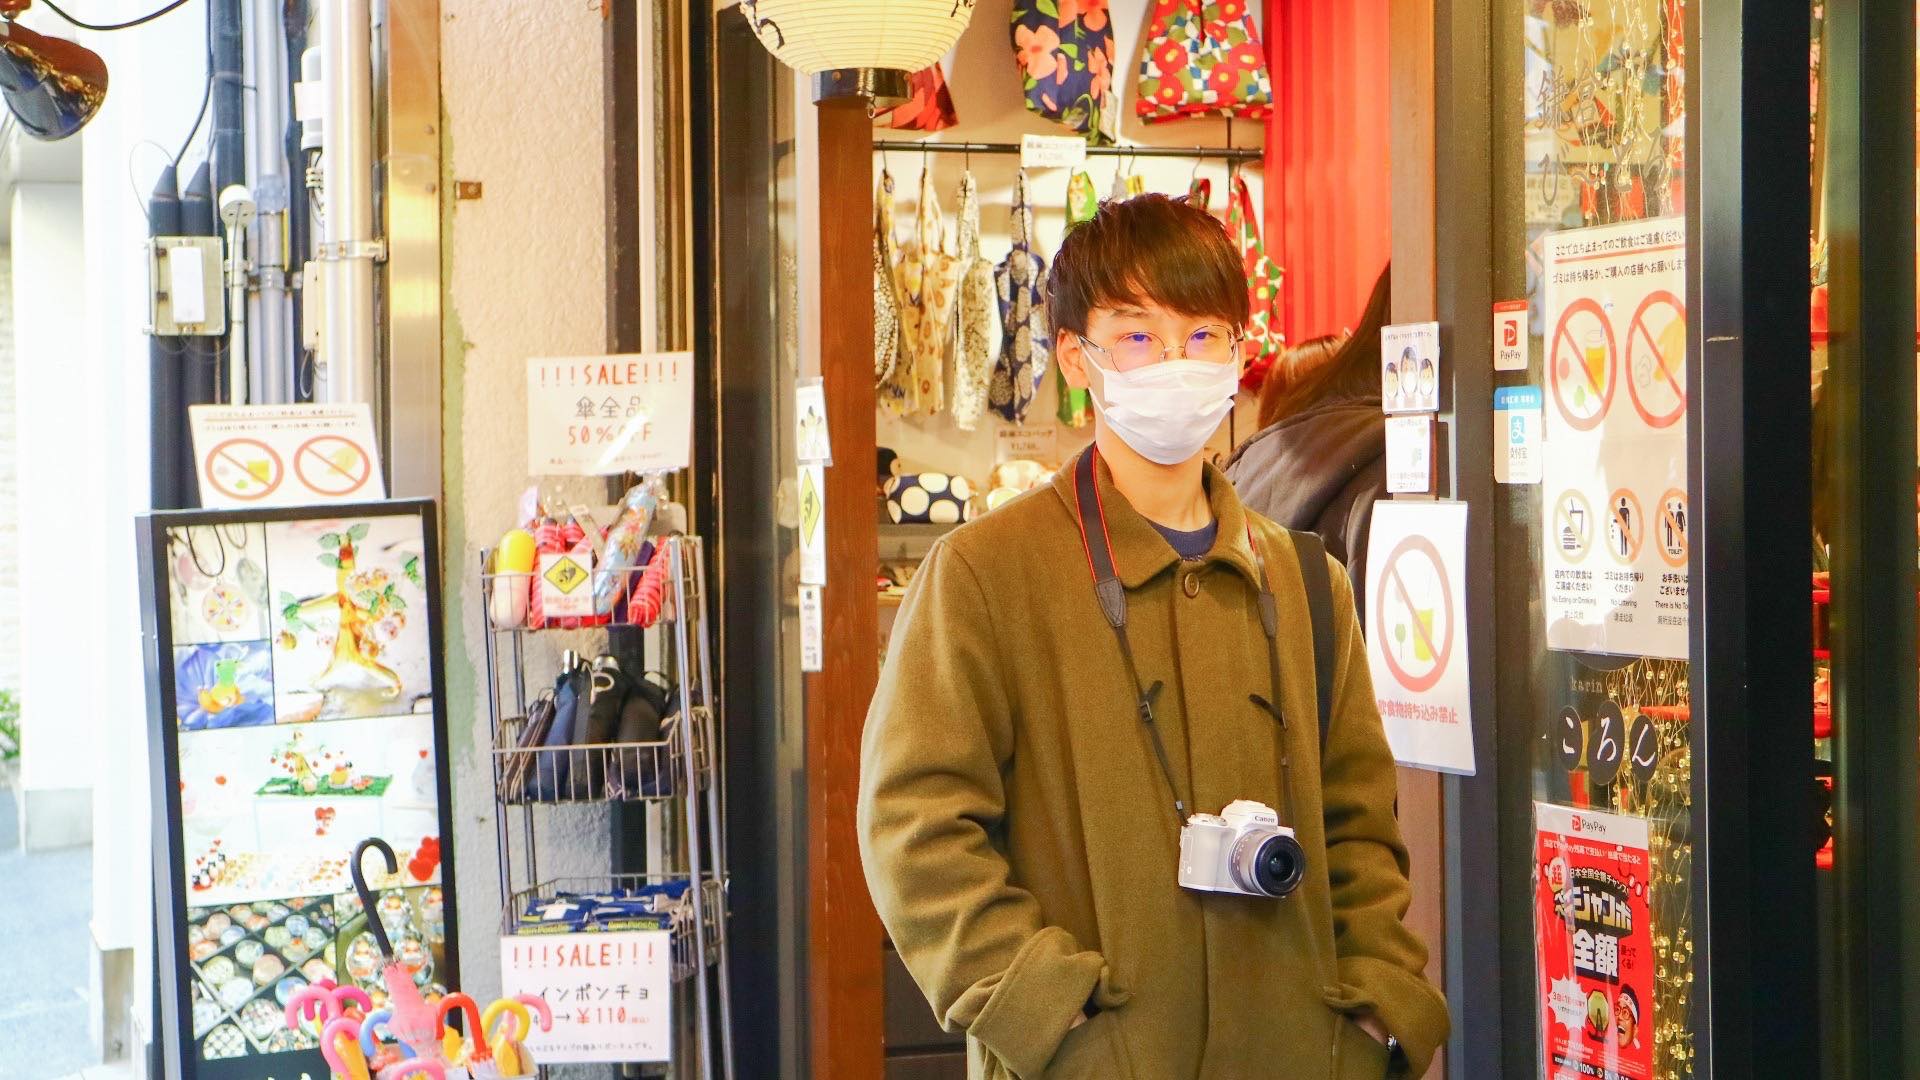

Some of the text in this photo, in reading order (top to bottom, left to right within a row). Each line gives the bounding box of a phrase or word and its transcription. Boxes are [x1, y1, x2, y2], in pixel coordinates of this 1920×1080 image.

[1500, 350, 1521, 364] PayPay
[568, 422, 652, 445] 50%F
[1614, 583, 1634, 593] ください
[1655, 600, 1668, 608] There
[1562, 716, 1656, 767] ころん
[1254, 815, 1275, 823] Canon
[1582, 820, 1607, 836] PayPay
[1573, 929, 1618, 977] 全額
